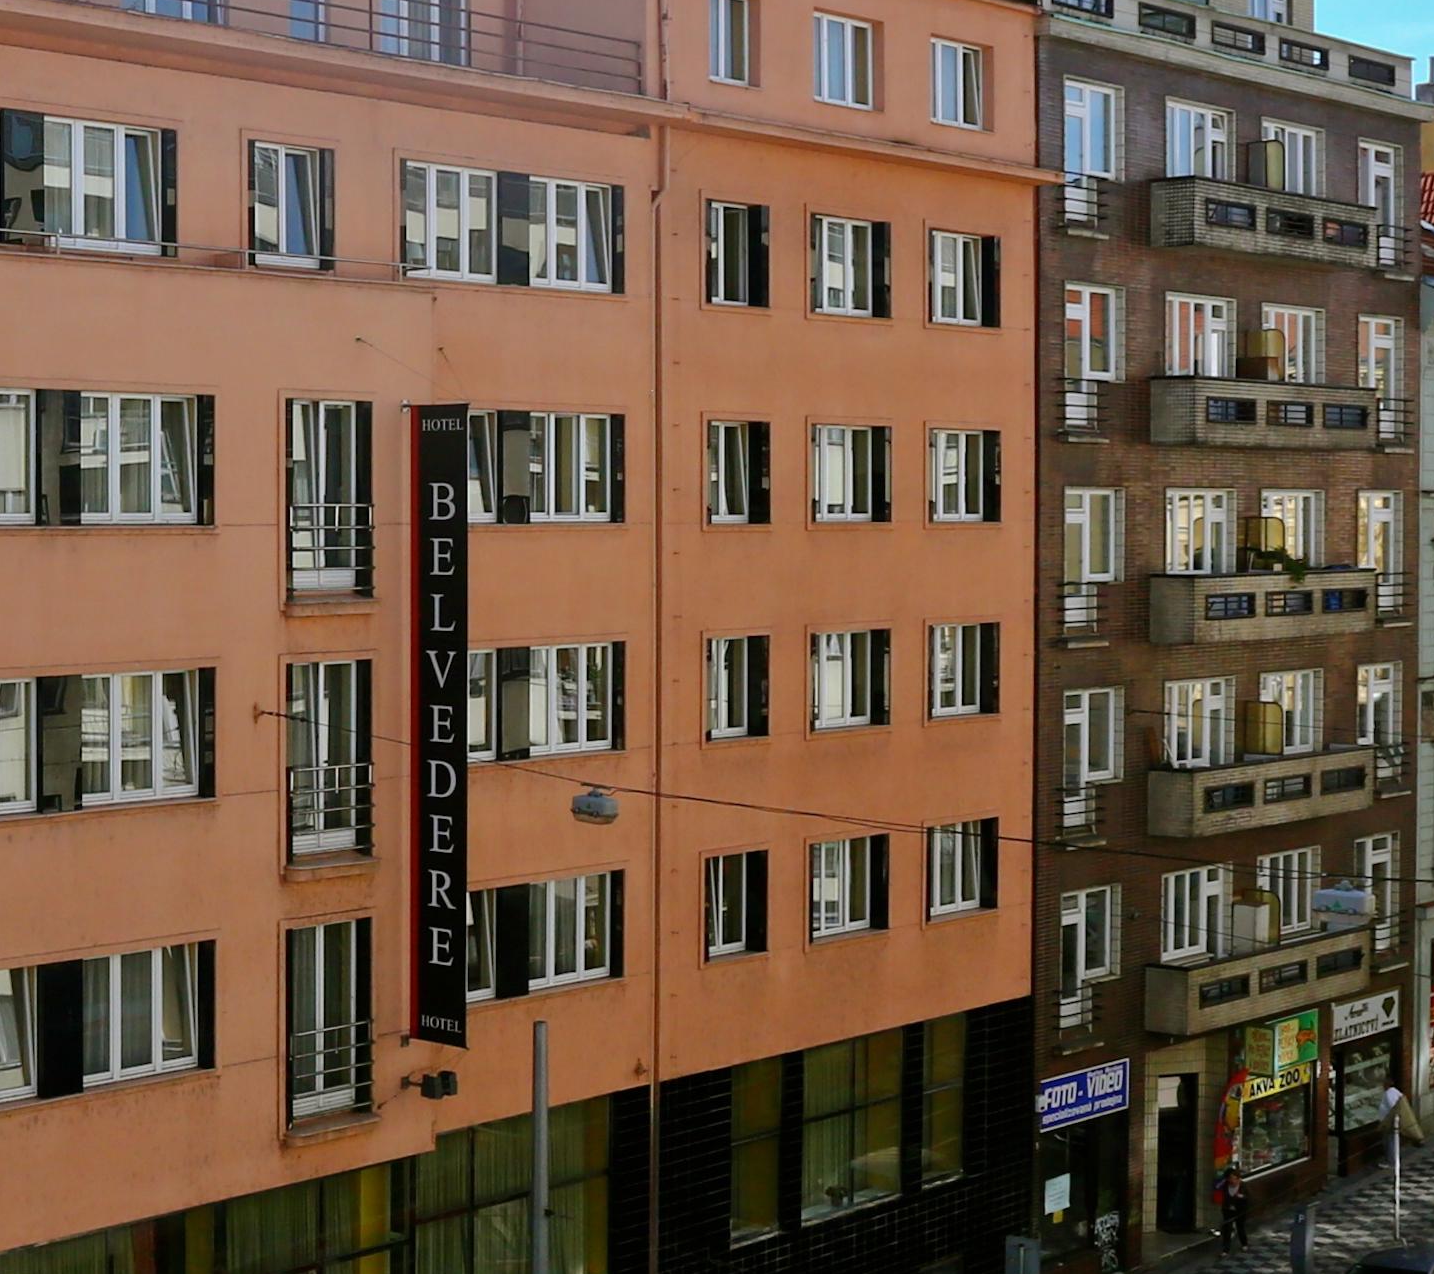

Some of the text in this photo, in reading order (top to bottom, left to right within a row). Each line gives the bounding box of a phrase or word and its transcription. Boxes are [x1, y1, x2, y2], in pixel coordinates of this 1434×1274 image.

[421, 416, 464, 432] HOTEL
[426, 481, 458, 967] BELVEDERE
[421, 1015, 463, 1034] HOTEL
[1279, 1068, 1300, 1087] ZOO
[1043, 1081, 1077, 1112] FOTO
